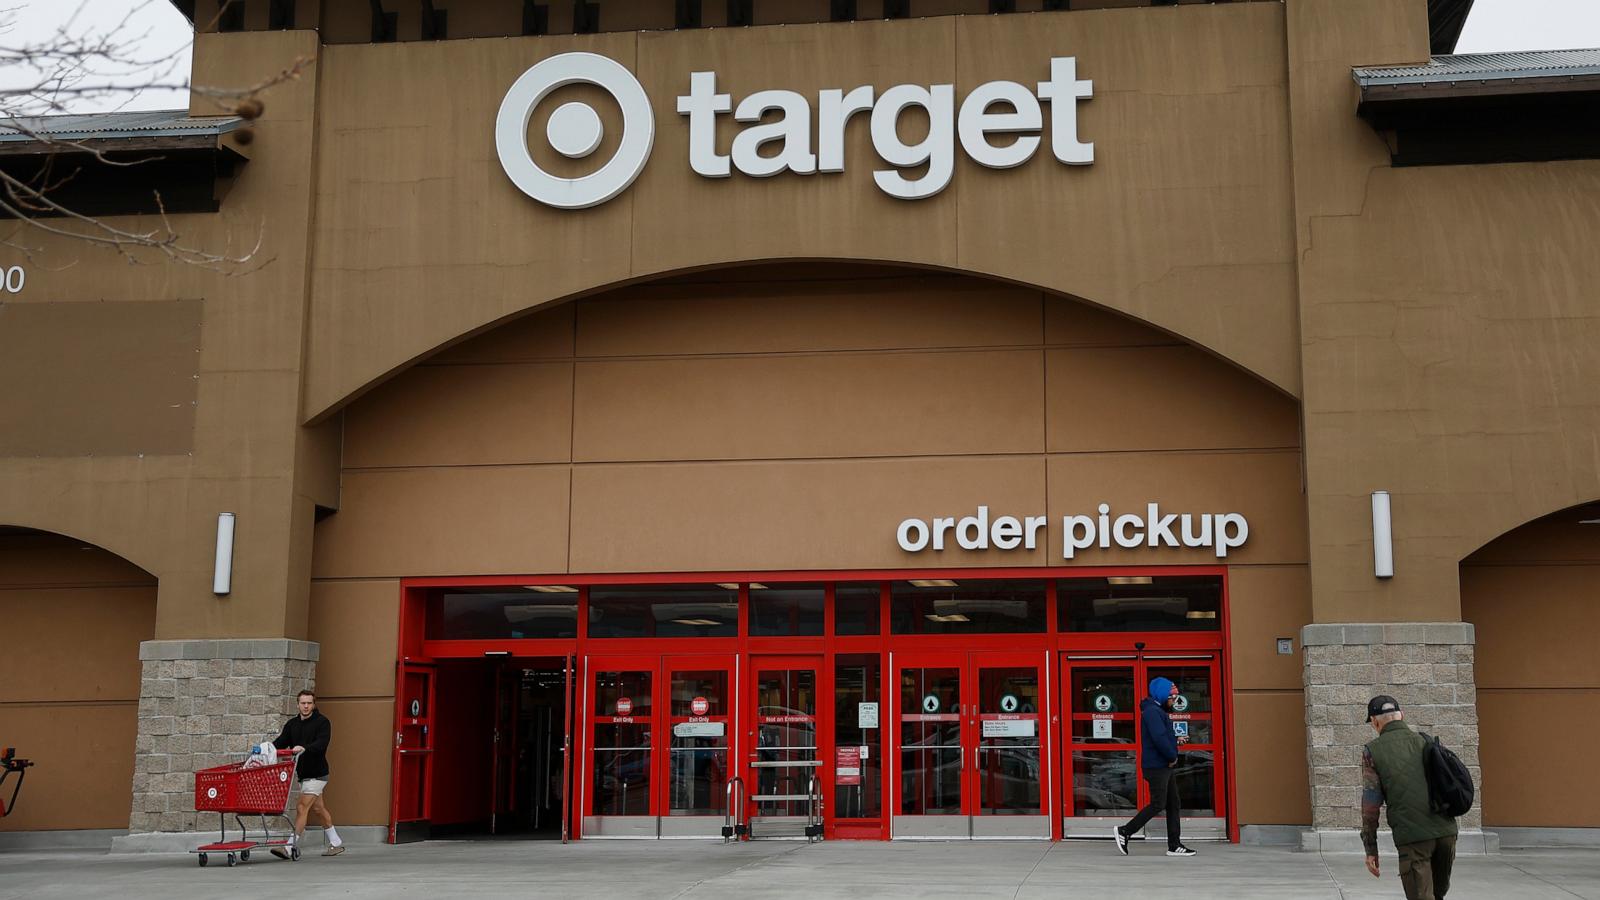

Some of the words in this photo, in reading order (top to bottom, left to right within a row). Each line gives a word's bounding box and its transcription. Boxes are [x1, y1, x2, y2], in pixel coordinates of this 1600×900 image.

[677, 56, 1094, 200] target
[0, 266, 25, 293] 0
[897, 506, 1047, 552] order
[1063, 502, 1250, 559] pickup
